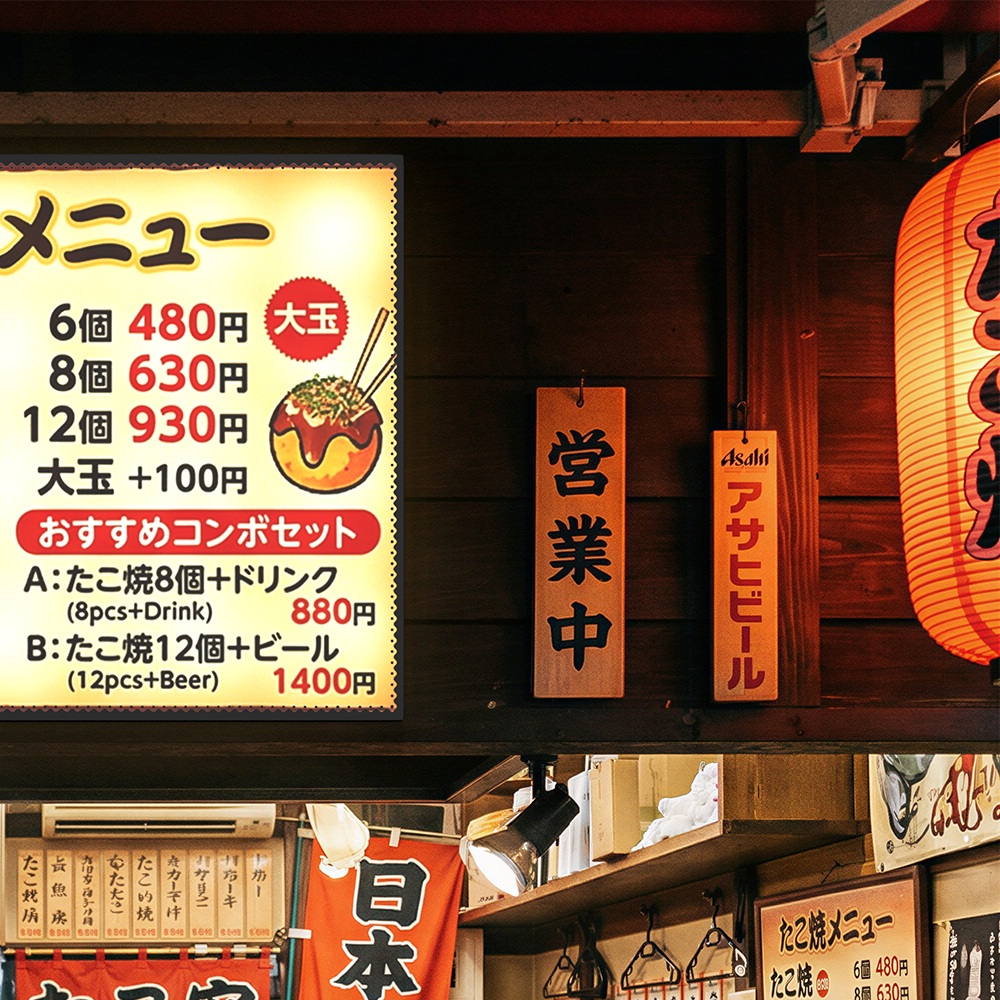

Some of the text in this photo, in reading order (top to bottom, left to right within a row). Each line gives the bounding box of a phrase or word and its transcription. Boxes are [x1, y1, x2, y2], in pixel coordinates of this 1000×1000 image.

[49, 303, 248, 343] 6個 480円
[273, 302, 340, 336] 大玉
[49, 354, 248, 393] 8個 630円
[22, 405, 248, 445] 12個 930円
[720, 447, 770, 468] Asahi
[37, 458, 248, 496] 大玉 +100円
[39, 513, 357, 550] おすすめコンボセット
[547, 428, 616, 672] 営業中
[726, 481, 765, 690] アサヒビール
[66, 601, 213, 626] (8pcs+Drink)
[291, 597, 376, 626] 880円
[67, 670, 219, 692] (12pcs+Beer)
[273, 667, 376, 695] 1400円
[779, 909, 893, 953] たこ焼メニュー
[770, 962, 813, 999] たこ焼
[875, 955, 909, 977] 480円
